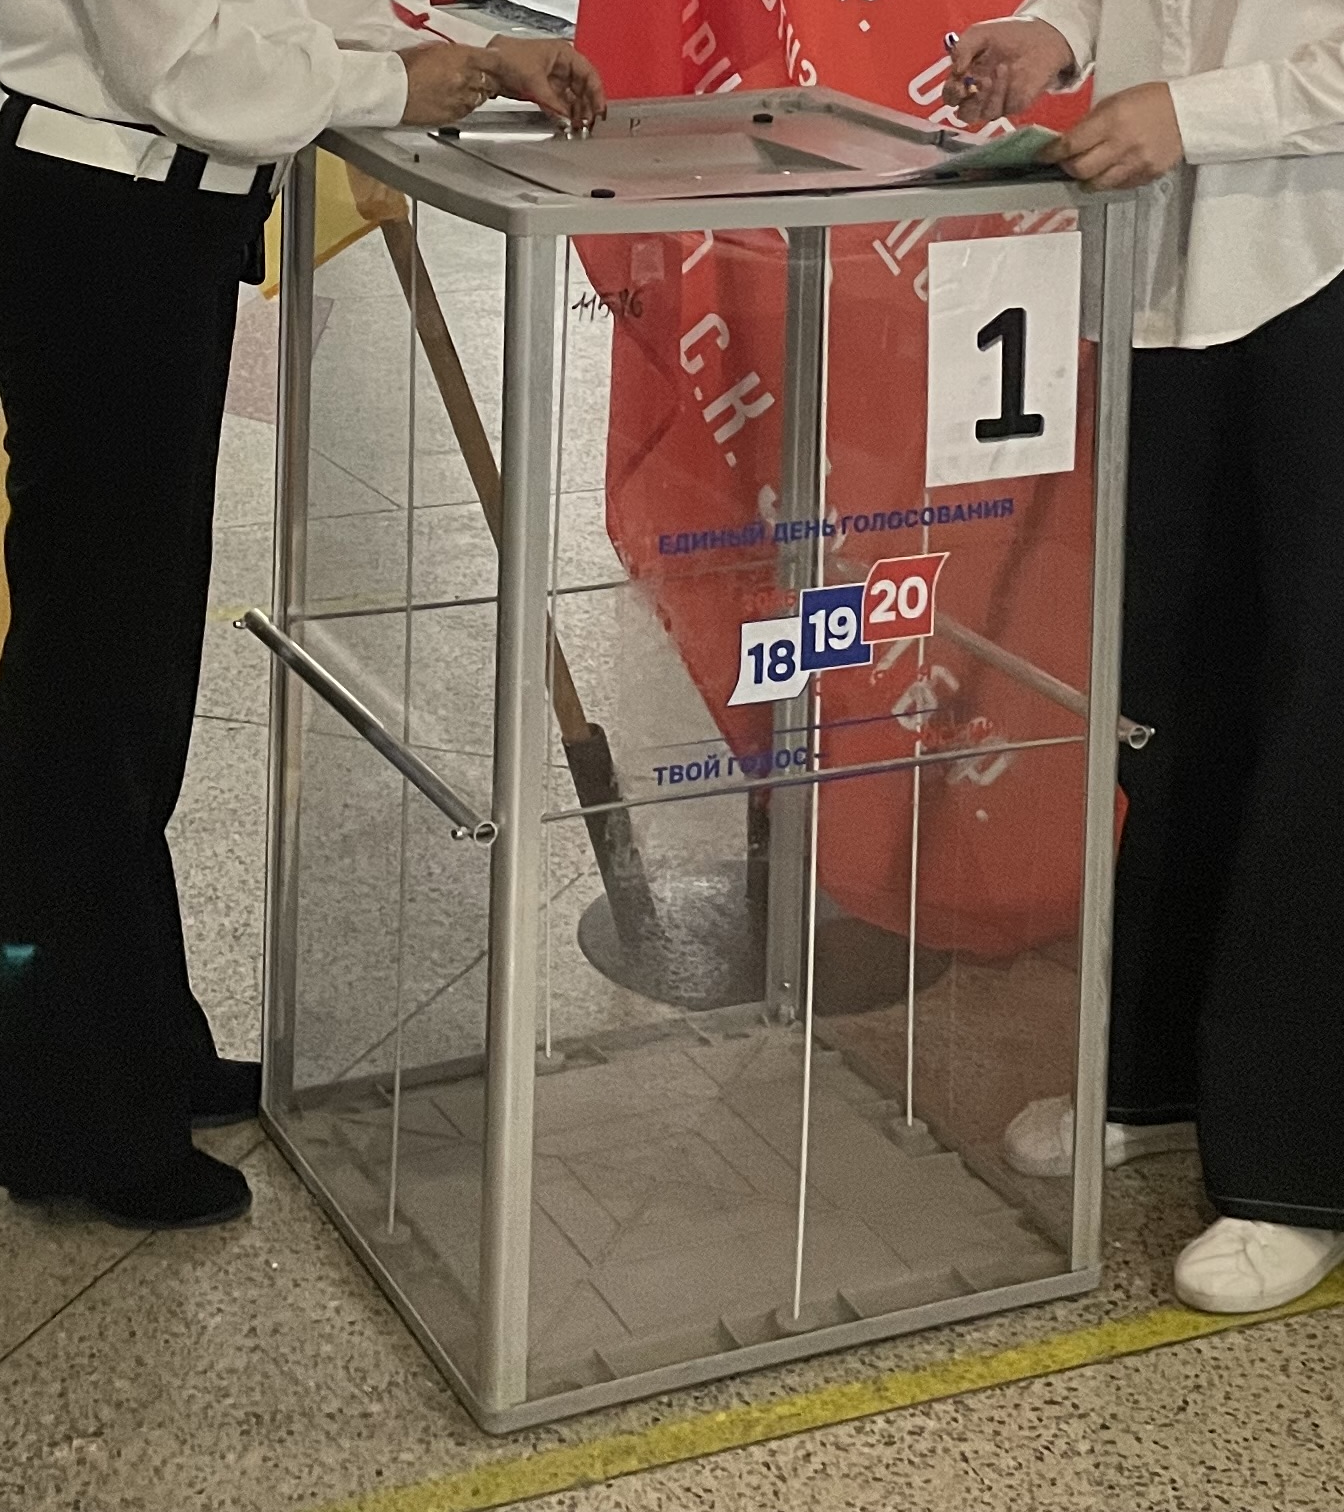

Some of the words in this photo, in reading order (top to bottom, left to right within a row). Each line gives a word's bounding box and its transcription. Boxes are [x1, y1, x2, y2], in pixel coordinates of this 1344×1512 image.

[974, 307, 1045, 443] 1
[659, 521, 765, 555] ЕДИНЫЙ
[774, 516, 836, 545] ДЕНЬ
[840, 498, 1014, 534] ГОЛОСОВАНИЯ
[747, 639, 796, 685] 18
[808, 606, 857, 652] 19
[868, 576, 928, 623] 20
[653, 755, 720, 786] ТВОЙ
